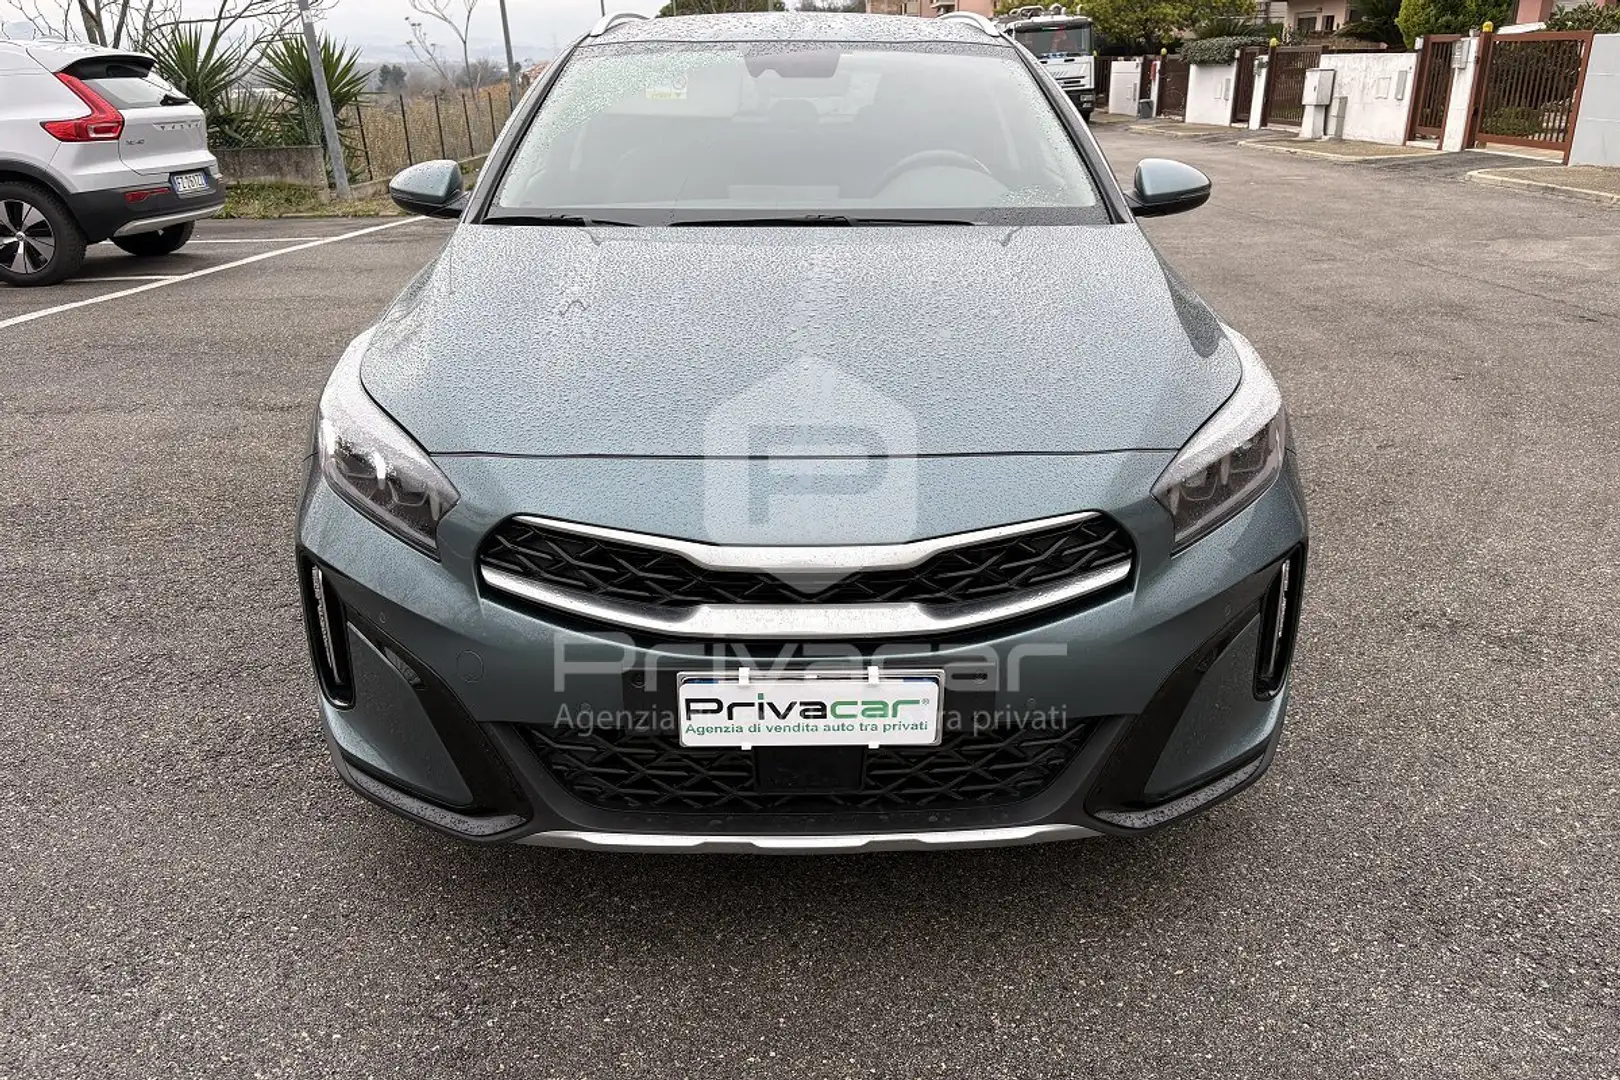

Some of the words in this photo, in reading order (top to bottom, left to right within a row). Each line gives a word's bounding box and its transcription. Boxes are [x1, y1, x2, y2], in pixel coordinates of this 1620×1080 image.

[685, 724, 743, 736] Agenzia
[748, 723, 761, 733] di
[766, 722, 818, 733] vendita
[823, 722, 854, 732] auto
[860, 722, 878, 732] tra
[883, 720, 928, 733] privati
